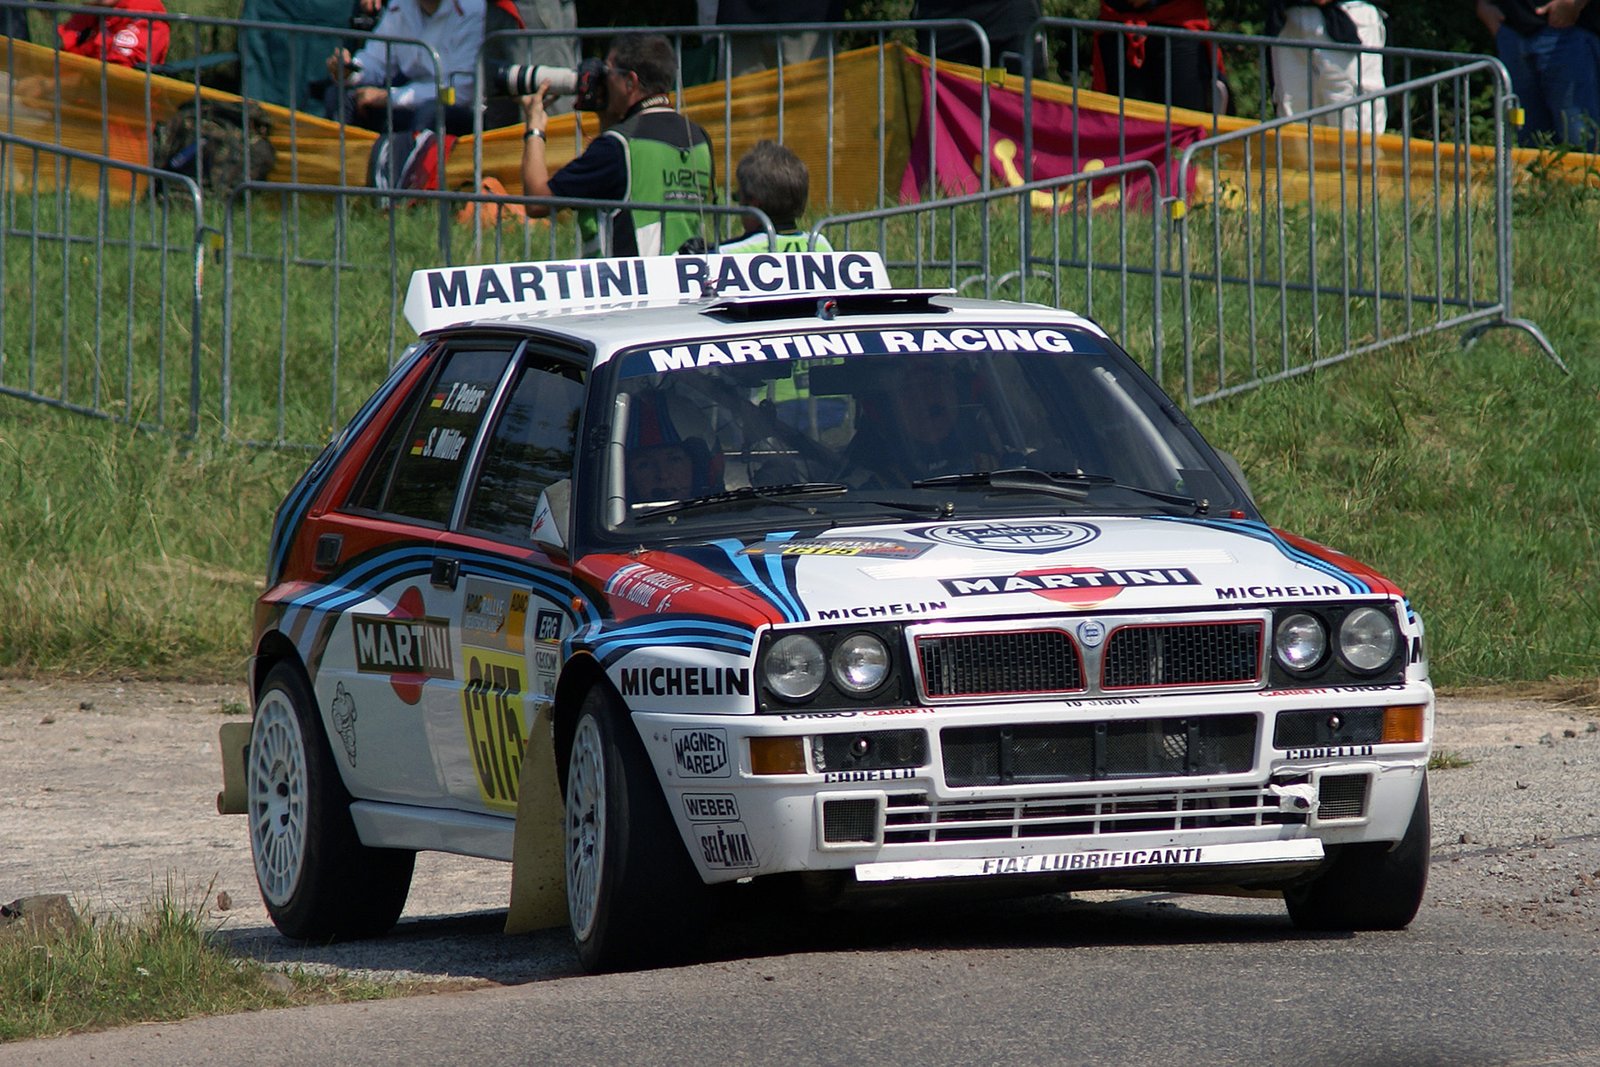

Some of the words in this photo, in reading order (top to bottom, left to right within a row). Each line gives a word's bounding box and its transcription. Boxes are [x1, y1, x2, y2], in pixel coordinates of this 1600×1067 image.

[427, 259, 648, 308] MARTINI
[676, 254, 875, 294] RACING
[648, 332, 864, 372] MARTINI
[881, 328, 1074, 354] RACING
[950, 568, 1186, 596] MARTINI
[1215, 585, 1341, 600] MICHELIN
[817, 601, 947, 620] MICHELIN
[538, 614, 558, 639] ERG
[356, 622, 450, 670] MARTINI
[620, 667, 749, 696] MICHELIN
[685, 798, 736, 816] WEBER
[982, 856, 1035, 874] FIAT
[1039, 847, 1203, 872] LUBRIFICANTI
